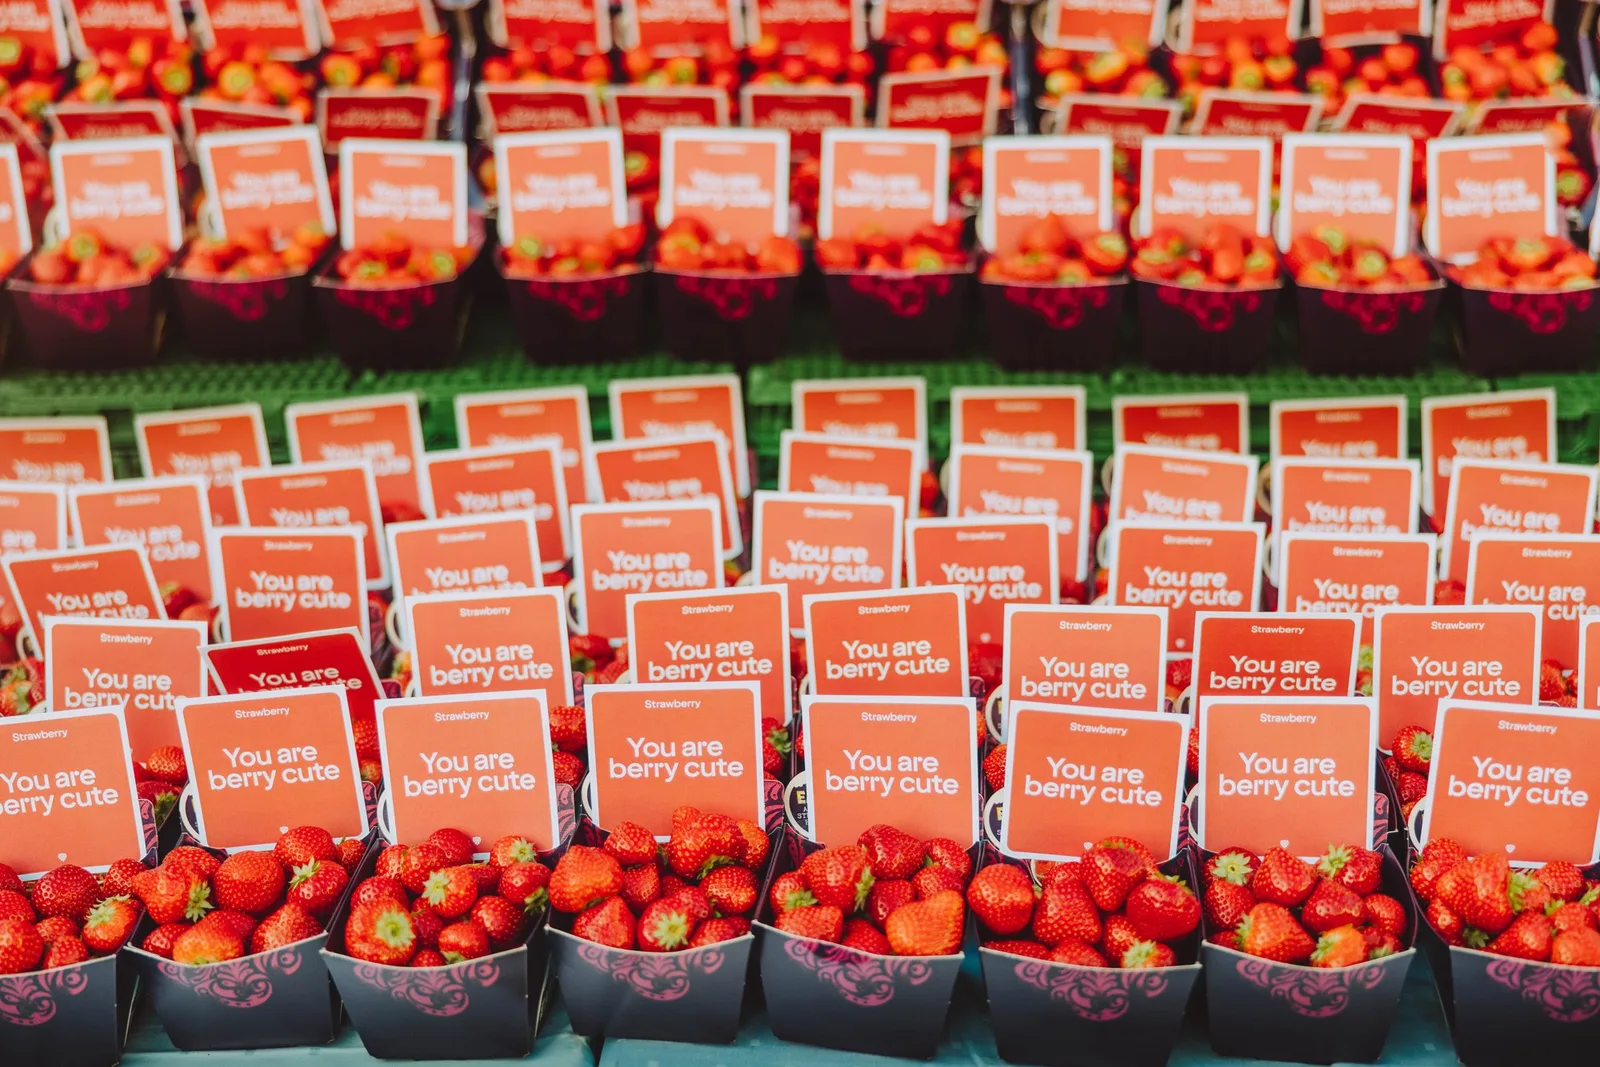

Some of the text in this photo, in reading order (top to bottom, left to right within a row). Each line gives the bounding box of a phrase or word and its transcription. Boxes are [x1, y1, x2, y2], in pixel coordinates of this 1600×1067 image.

[607, 551, 691, 571] You are
[786, 540, 869, 563] You are
[250, 571, 334, 591] You are
[425, 565, 509, 588] You are
[593, 568, 708, 592] berry cute
[770, 558, 884, 584] berry cute
[940, 562, 1025, 581] You are
[1143, 566, 1228, 588] You are
[46, 590, 128, 611] You are
[236, 588, 351, 611] berry cute
[989, 581, 1042, 598] cute
[1125, 583, 1243, 608] berry cute
[1313, 579, 1400, 600] You are
[1501, 580, 1587, 602] You are
[459, 606, 511, 617] Strawberry
[681, 604, 734, 615] Strawberry
[858, 604, 910, 615] Strawberry
[1059, 620, 1112, 632] Strawberry
[1250, 625, 1304, 635] Strawberry
[1430, 620, 1485, 631] Strawberry
[100, 633, 153, 645] Strawberry
[841, 639, 932, 660] You are
[256, 645, 308, 656] Strawberry
[445, 643, 534, 665] You are
[664, 640, 755, 661] You are
[430, 660, 554, 687] berry cute
[648, 656, 773, 682] berry cute
[826, 655, 951, 681] berry cute
[1039, 656, 1130, 679] You are
[1229, 655, 1321, 675] You are
[1410, 656, 1503, 677] You are
[82, 667, 172, 691] You are
[248, 667, 340, 687] You are
[1209, 671, 1338, 694] berry cute
[1392, 675, 1521, 700] berry cute
[65, 686, 130, 712] berry
[1021, 675, 1147, 702] berry cute
[235, 707, 289, 719] Strawberry
[644, 699, 701, 709] Strawberry
[434, 711, 489, 722] Strawberry
[861, 711, 917, 723] Strawberry
[1260, 713, 1317, 724] Strawberry
[1498, 720, 1557, 734] Strawberry
[12, 730, 67, 742] Strawberry
[1070, 722, 1127, 736] Strawberry
[221, 745, 318, 768] You are
[626, 737, 724, 758] You are
[419, 751, 515, 774] You are
[609, 758, 744, 782] berry cute
[843, 749, 939, 773] You are
[1046, 757, 1145, 785] You are
[1238, 752, 1336, 775] You are
[1472, 756, 1572, 785] You are
[0, 768, 96, 794] You are
[208, 762, 340, 791] berry cute
[403, 770, 536, 798] berry cute
[825, 769, 959, 797] berry cute
[1219, 773, 1355, 801] berry cute
[59, 786, 119, 809] cute
[1025, 775, 1163, 807] berry cute
[1448, 775, 1589, 808] berry cute
